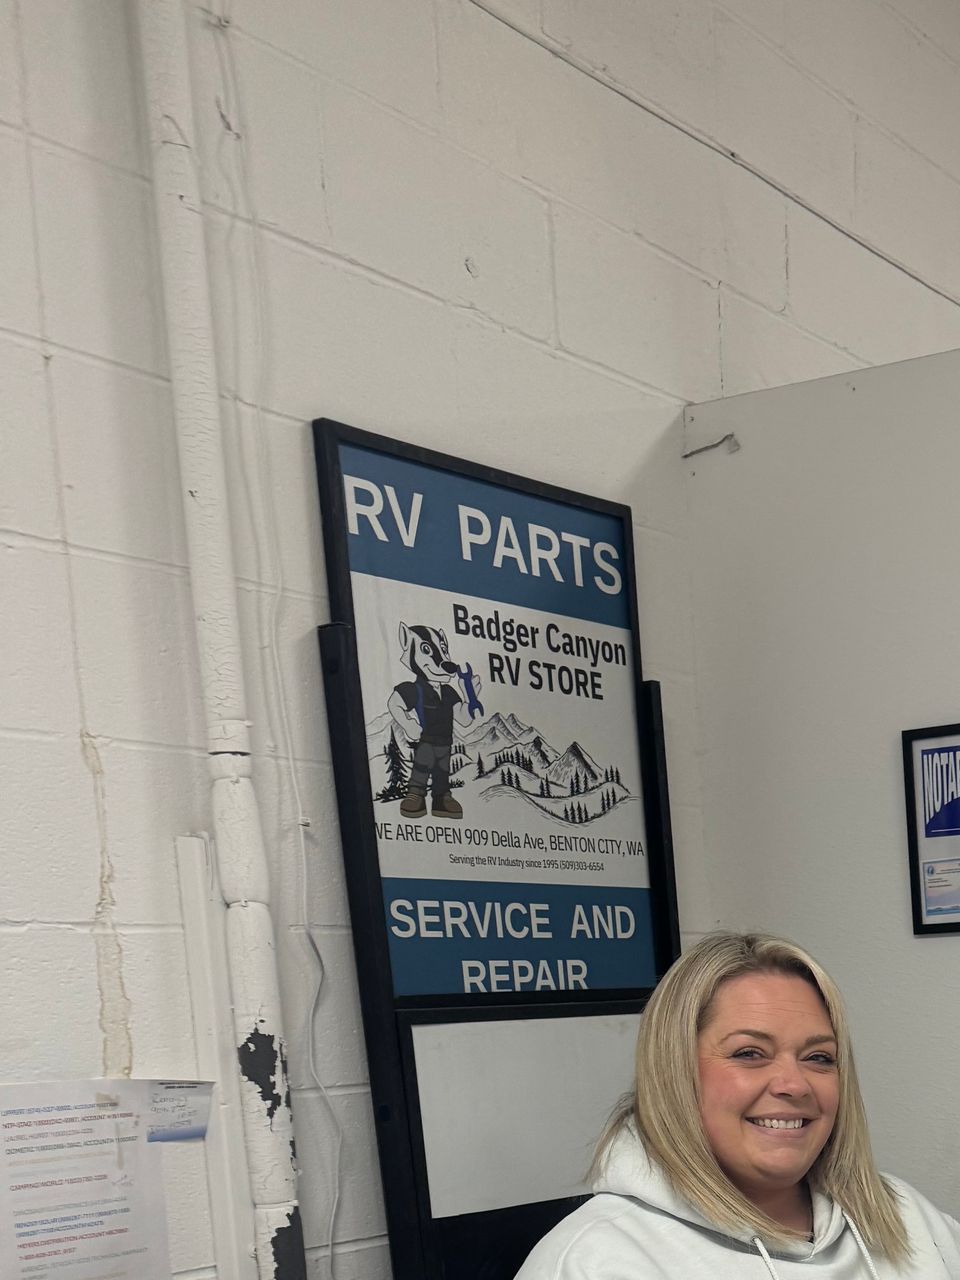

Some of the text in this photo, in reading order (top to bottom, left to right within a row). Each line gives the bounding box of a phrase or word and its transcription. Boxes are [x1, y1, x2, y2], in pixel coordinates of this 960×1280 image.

[343, 474, 623, 596] RV PARTS
[452, 603, 627, 667] Badger Canyon
[488, 653, 605, 700] RV STORE
[395, 823, 423, 842] ARE
[425, 825, 462, 845] OPEN
[464, 828, 489, 846] 909
[491, 830, 521, 849] Della
[523, 832, 548, 853] Ave,
[549, 834, 596, 854] BENTON
[597, 838, 626, 858] CITY,
[626, 840, 645, 857] WA
[448, 853, 475, 867] Serving
[475, 855, 487, 866] the
[487, 856, 497, 866] RV
[498, 856, 525, 870] Industry
[525, 859, 542, 868] since
[542, 859, 559, 870] 1995
[389, 898, 636, 940] SERVICE AND
[460, 959, 590, 994] REPAIR
